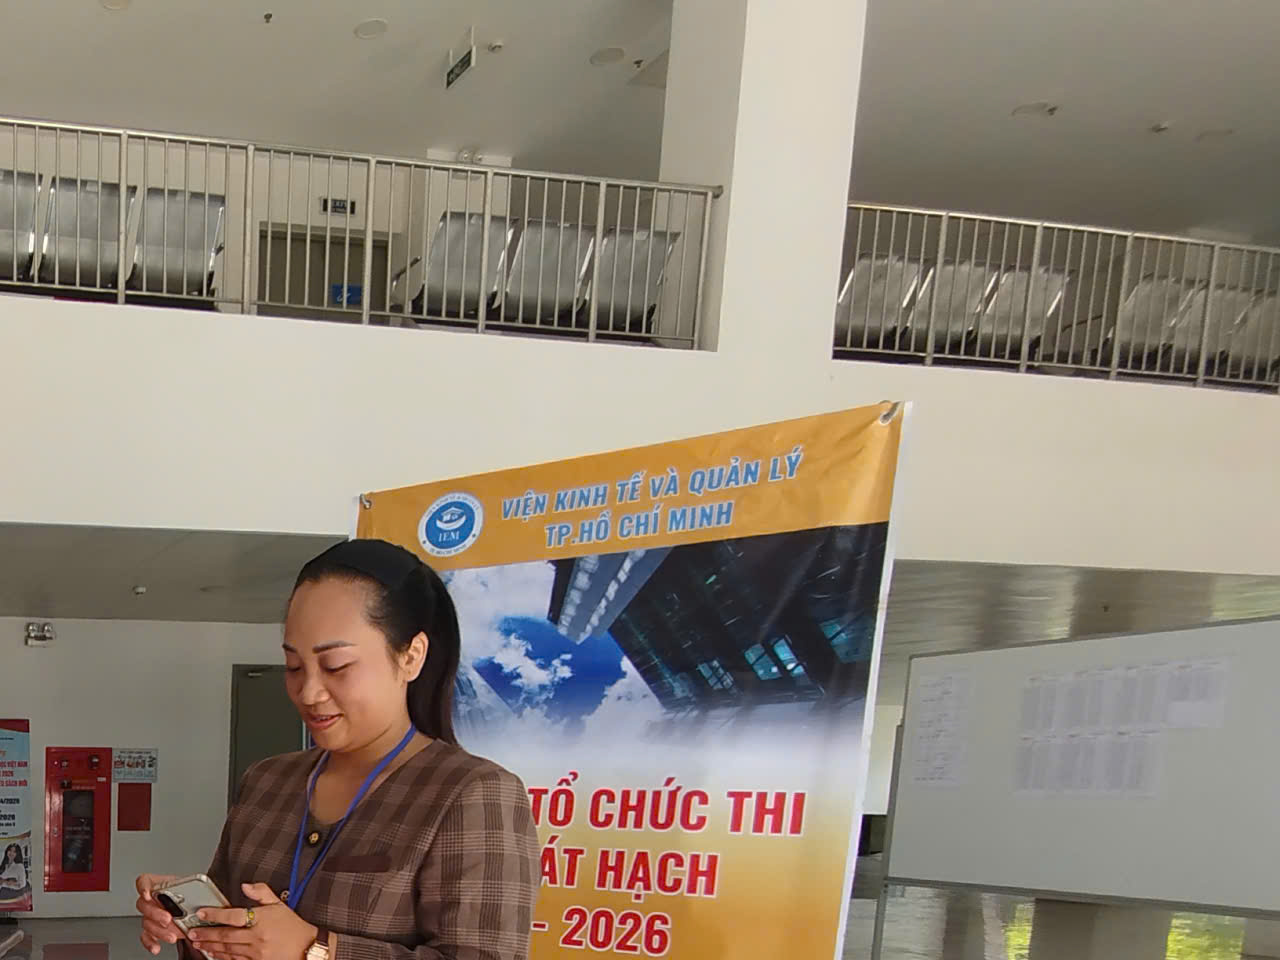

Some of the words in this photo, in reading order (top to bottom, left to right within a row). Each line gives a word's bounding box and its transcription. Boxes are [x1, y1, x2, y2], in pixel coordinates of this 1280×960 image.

[501, 489, 547, 522] VIỆN
[554, 483, 609, 512] KINH
[616, 470, 647, 502] TẾ
[650, 467, 680, 499] VÀ
[689, 456, 761, 496] QUẢN
[769, 446, 803, 482] LÝ
[545, 510, 611, 548] TP.HỒ
[618, 502, 663, 540] CHÍ
[668, 501, 734, 533] MINH
[527, 771, 580, 828] TỔ
[588, 776, 710, 833] CHỨC
[726, 789, 807, 837] THI
[539, 835, 585, 889] ÁT
[595, 848, 720, 902] HẠCH
[559, 906, 672, 957] 2026
